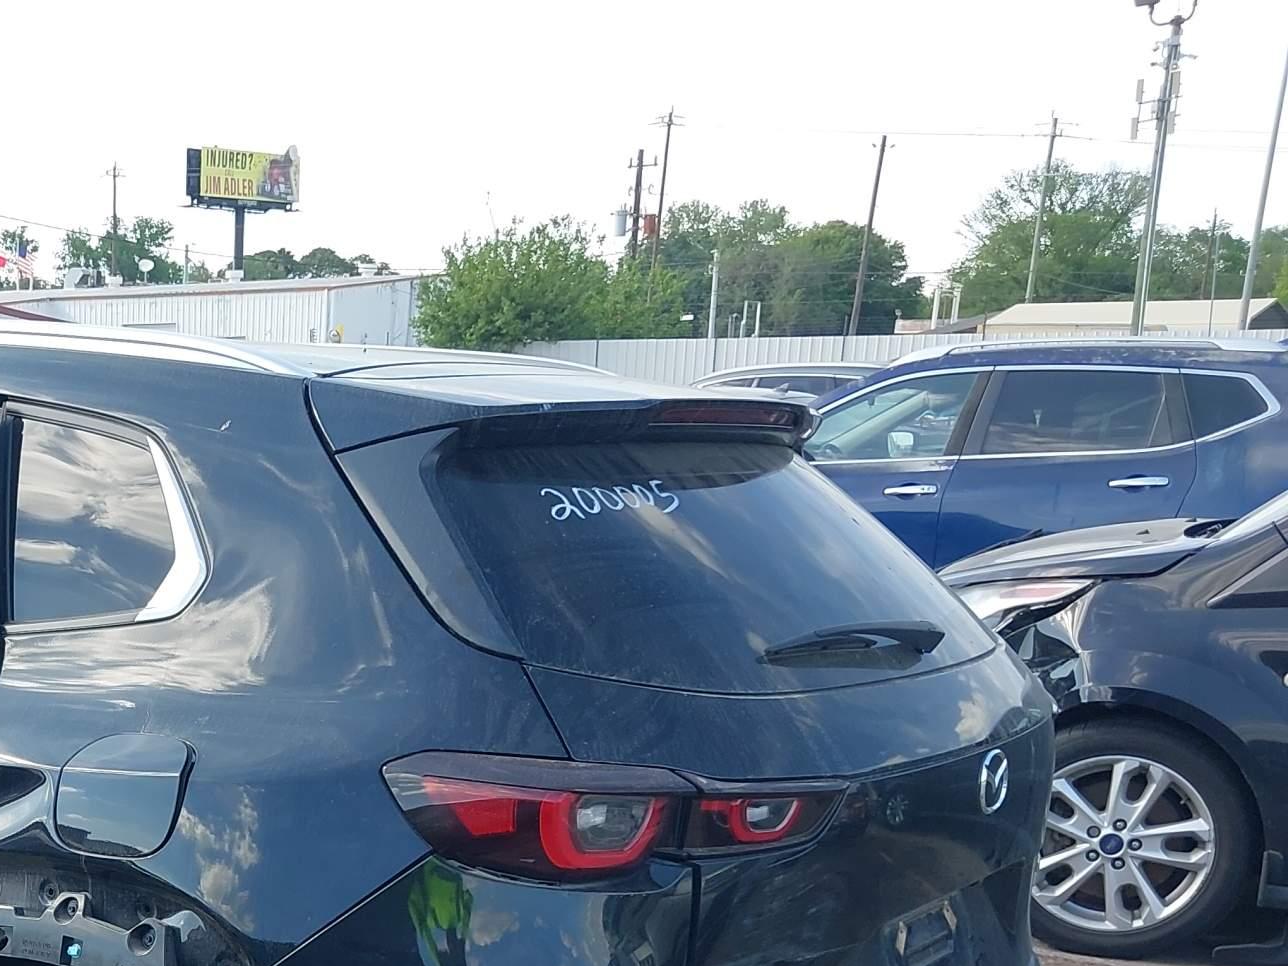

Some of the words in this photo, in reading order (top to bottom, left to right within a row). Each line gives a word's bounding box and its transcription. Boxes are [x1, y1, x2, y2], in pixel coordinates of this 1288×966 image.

[206, 149, 253, 171] INJURED?
[204, 175, 222, 194] JIM
[223, 176, 254, 197] ADLER
[540, 480, 680, 521] 200005
